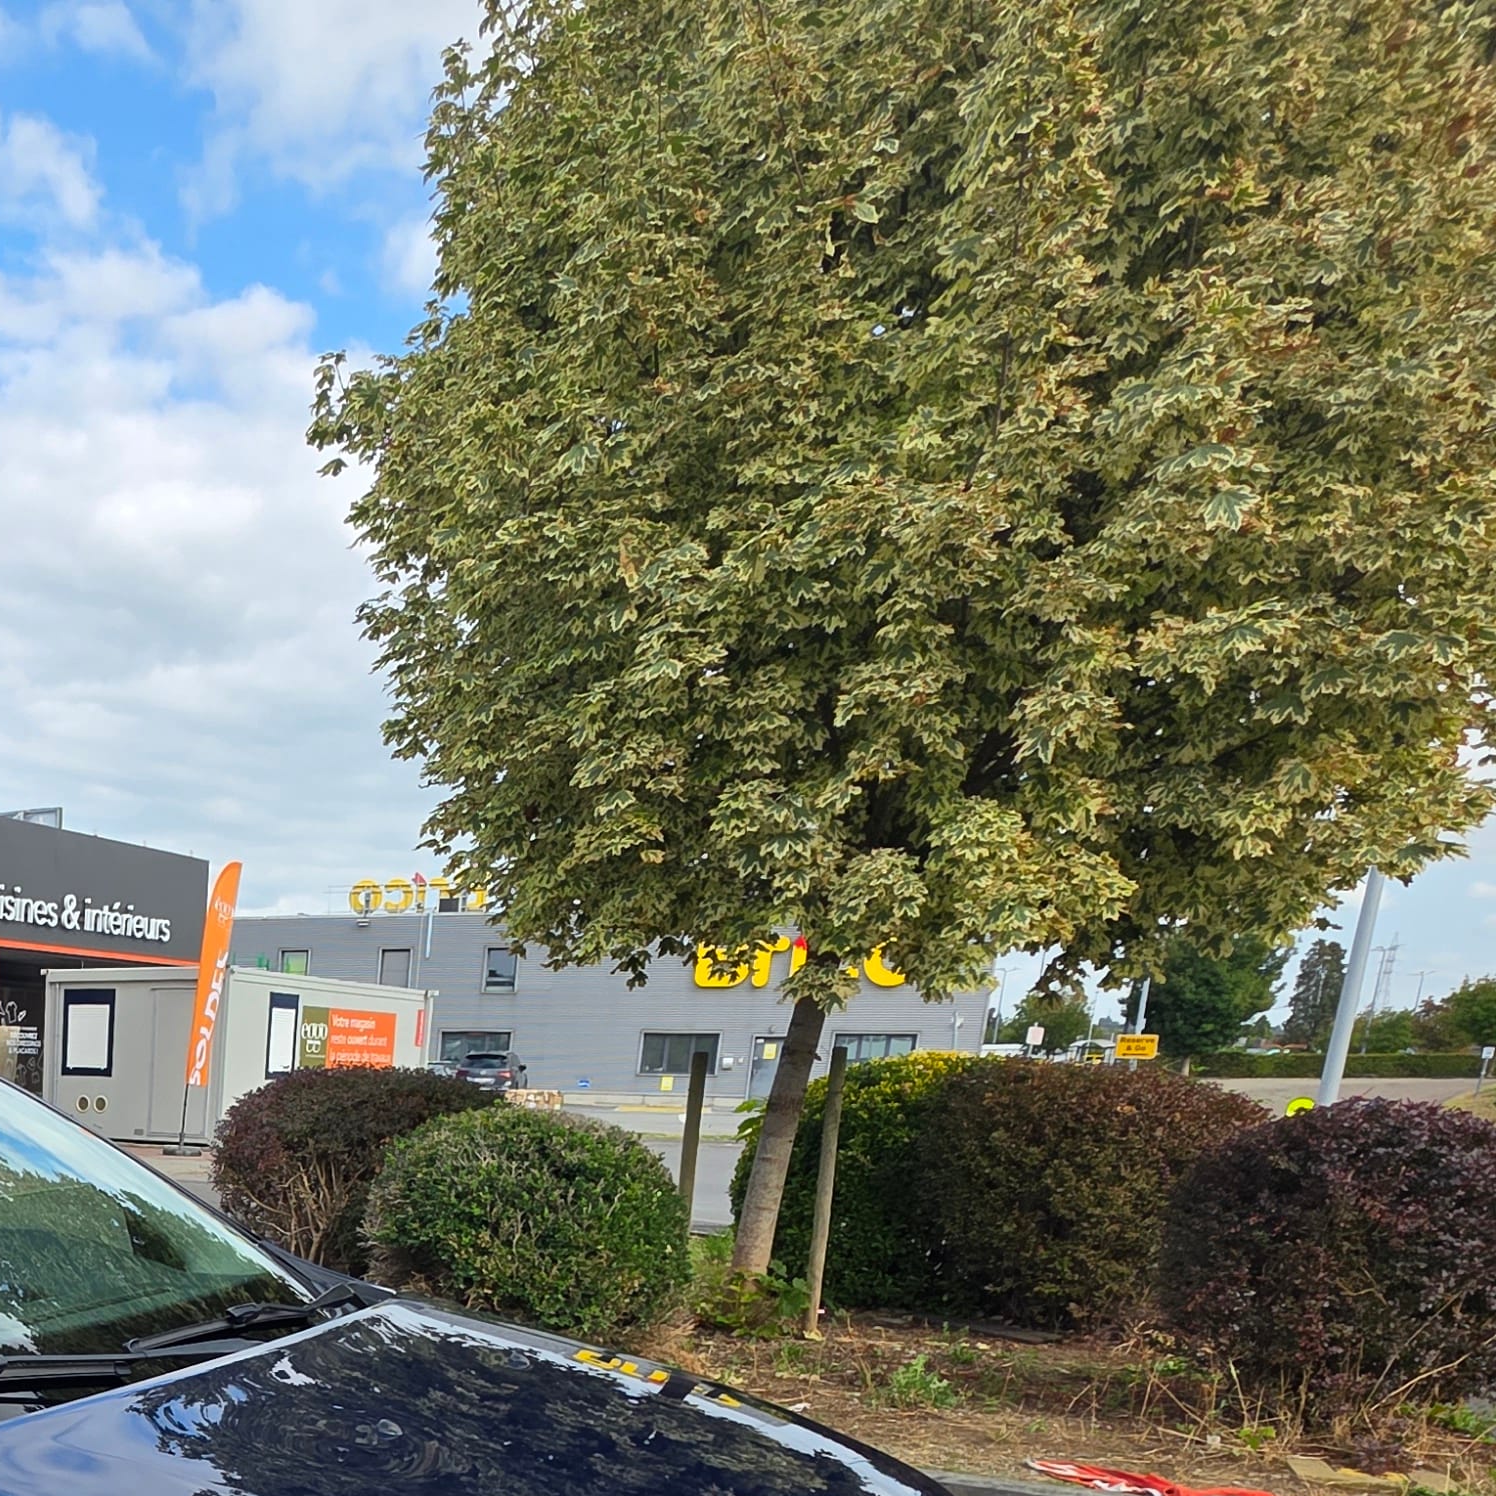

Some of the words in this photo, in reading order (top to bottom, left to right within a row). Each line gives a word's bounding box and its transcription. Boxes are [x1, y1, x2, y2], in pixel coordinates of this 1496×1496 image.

[61, 894, 81, 931] &
[84, 897, 171, 942] intérieurs
[331, 1014, 349, 1028] Votre
[350, 1017, 376, 1032] magasin
[347, 1035, 367, 1046] ouvert
